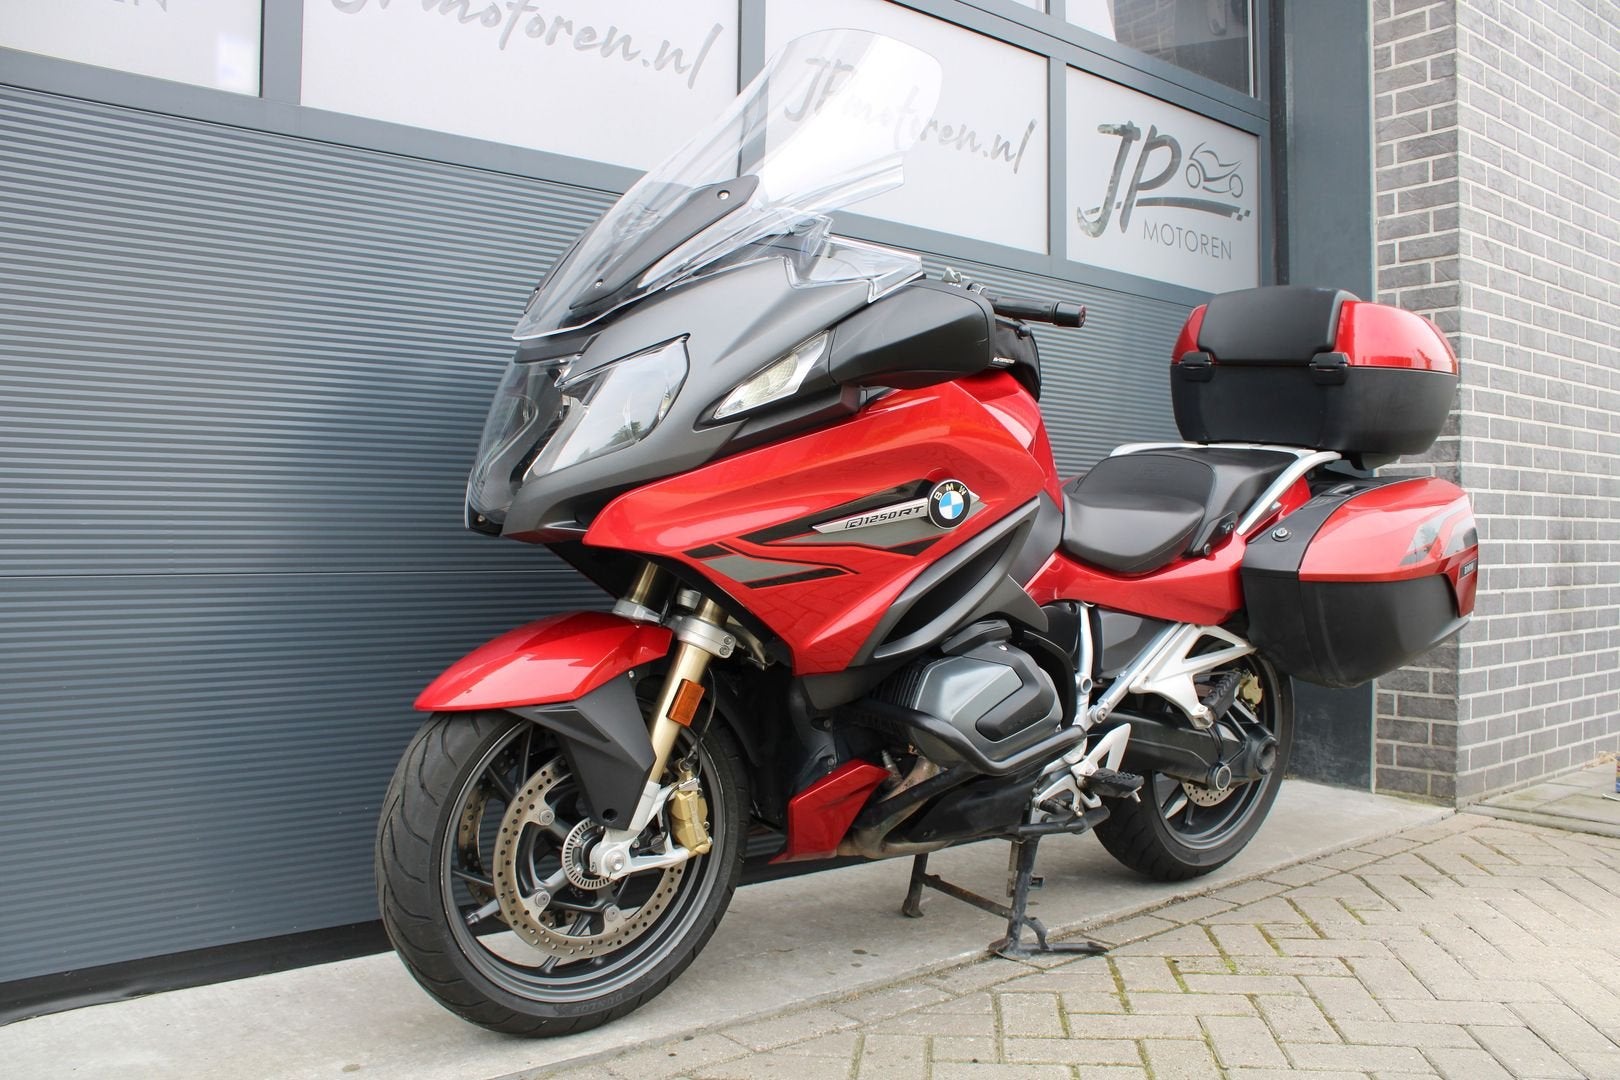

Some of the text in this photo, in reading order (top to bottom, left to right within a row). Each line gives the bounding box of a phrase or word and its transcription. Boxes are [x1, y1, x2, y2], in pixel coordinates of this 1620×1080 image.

[331, 0, 724, 89] motoren.nl
[1077, 120, 1182, 238] JP
[1143, 219, 1232, 260] MOTOREN
[934, 483, 967, 500] BMW
